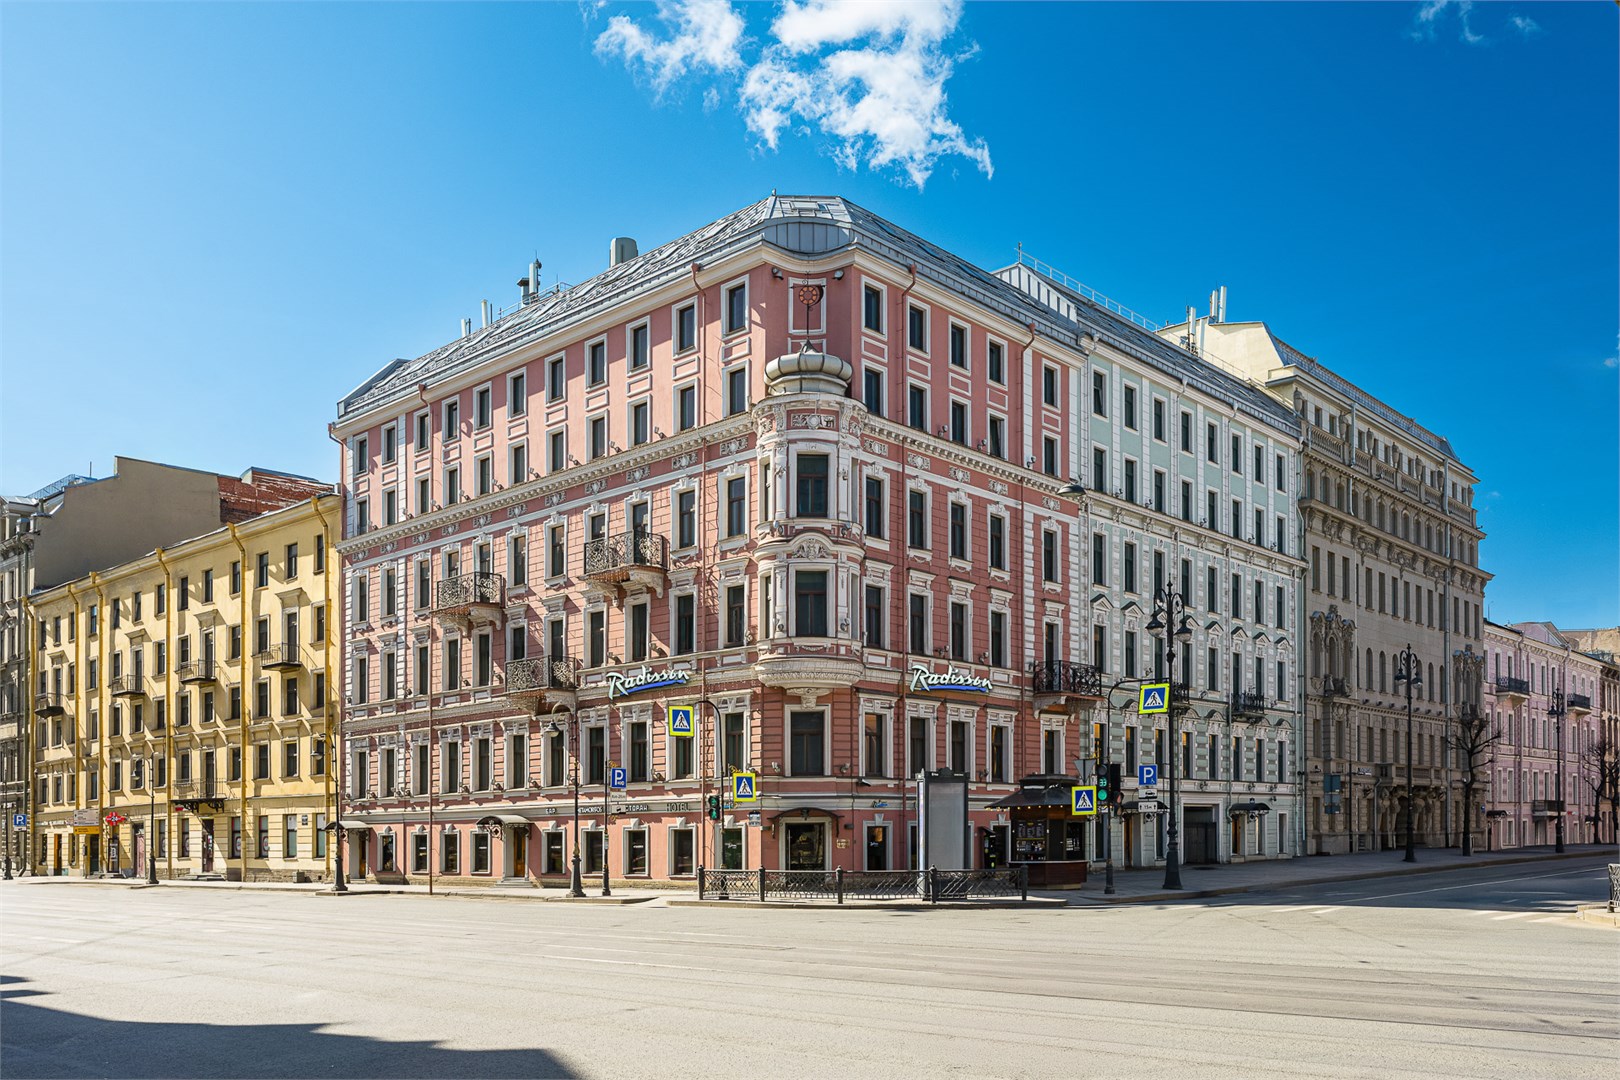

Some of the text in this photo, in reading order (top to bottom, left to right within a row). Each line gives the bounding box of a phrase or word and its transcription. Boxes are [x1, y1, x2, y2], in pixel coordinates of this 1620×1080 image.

[606, 664, 689, 700] Radisson
[910, 664, 993, 692] Radisson
[614, 769, 624, 785] P
[1143, 767, 1154, 783] P
[666, 802, 690, 812] HOTEL
